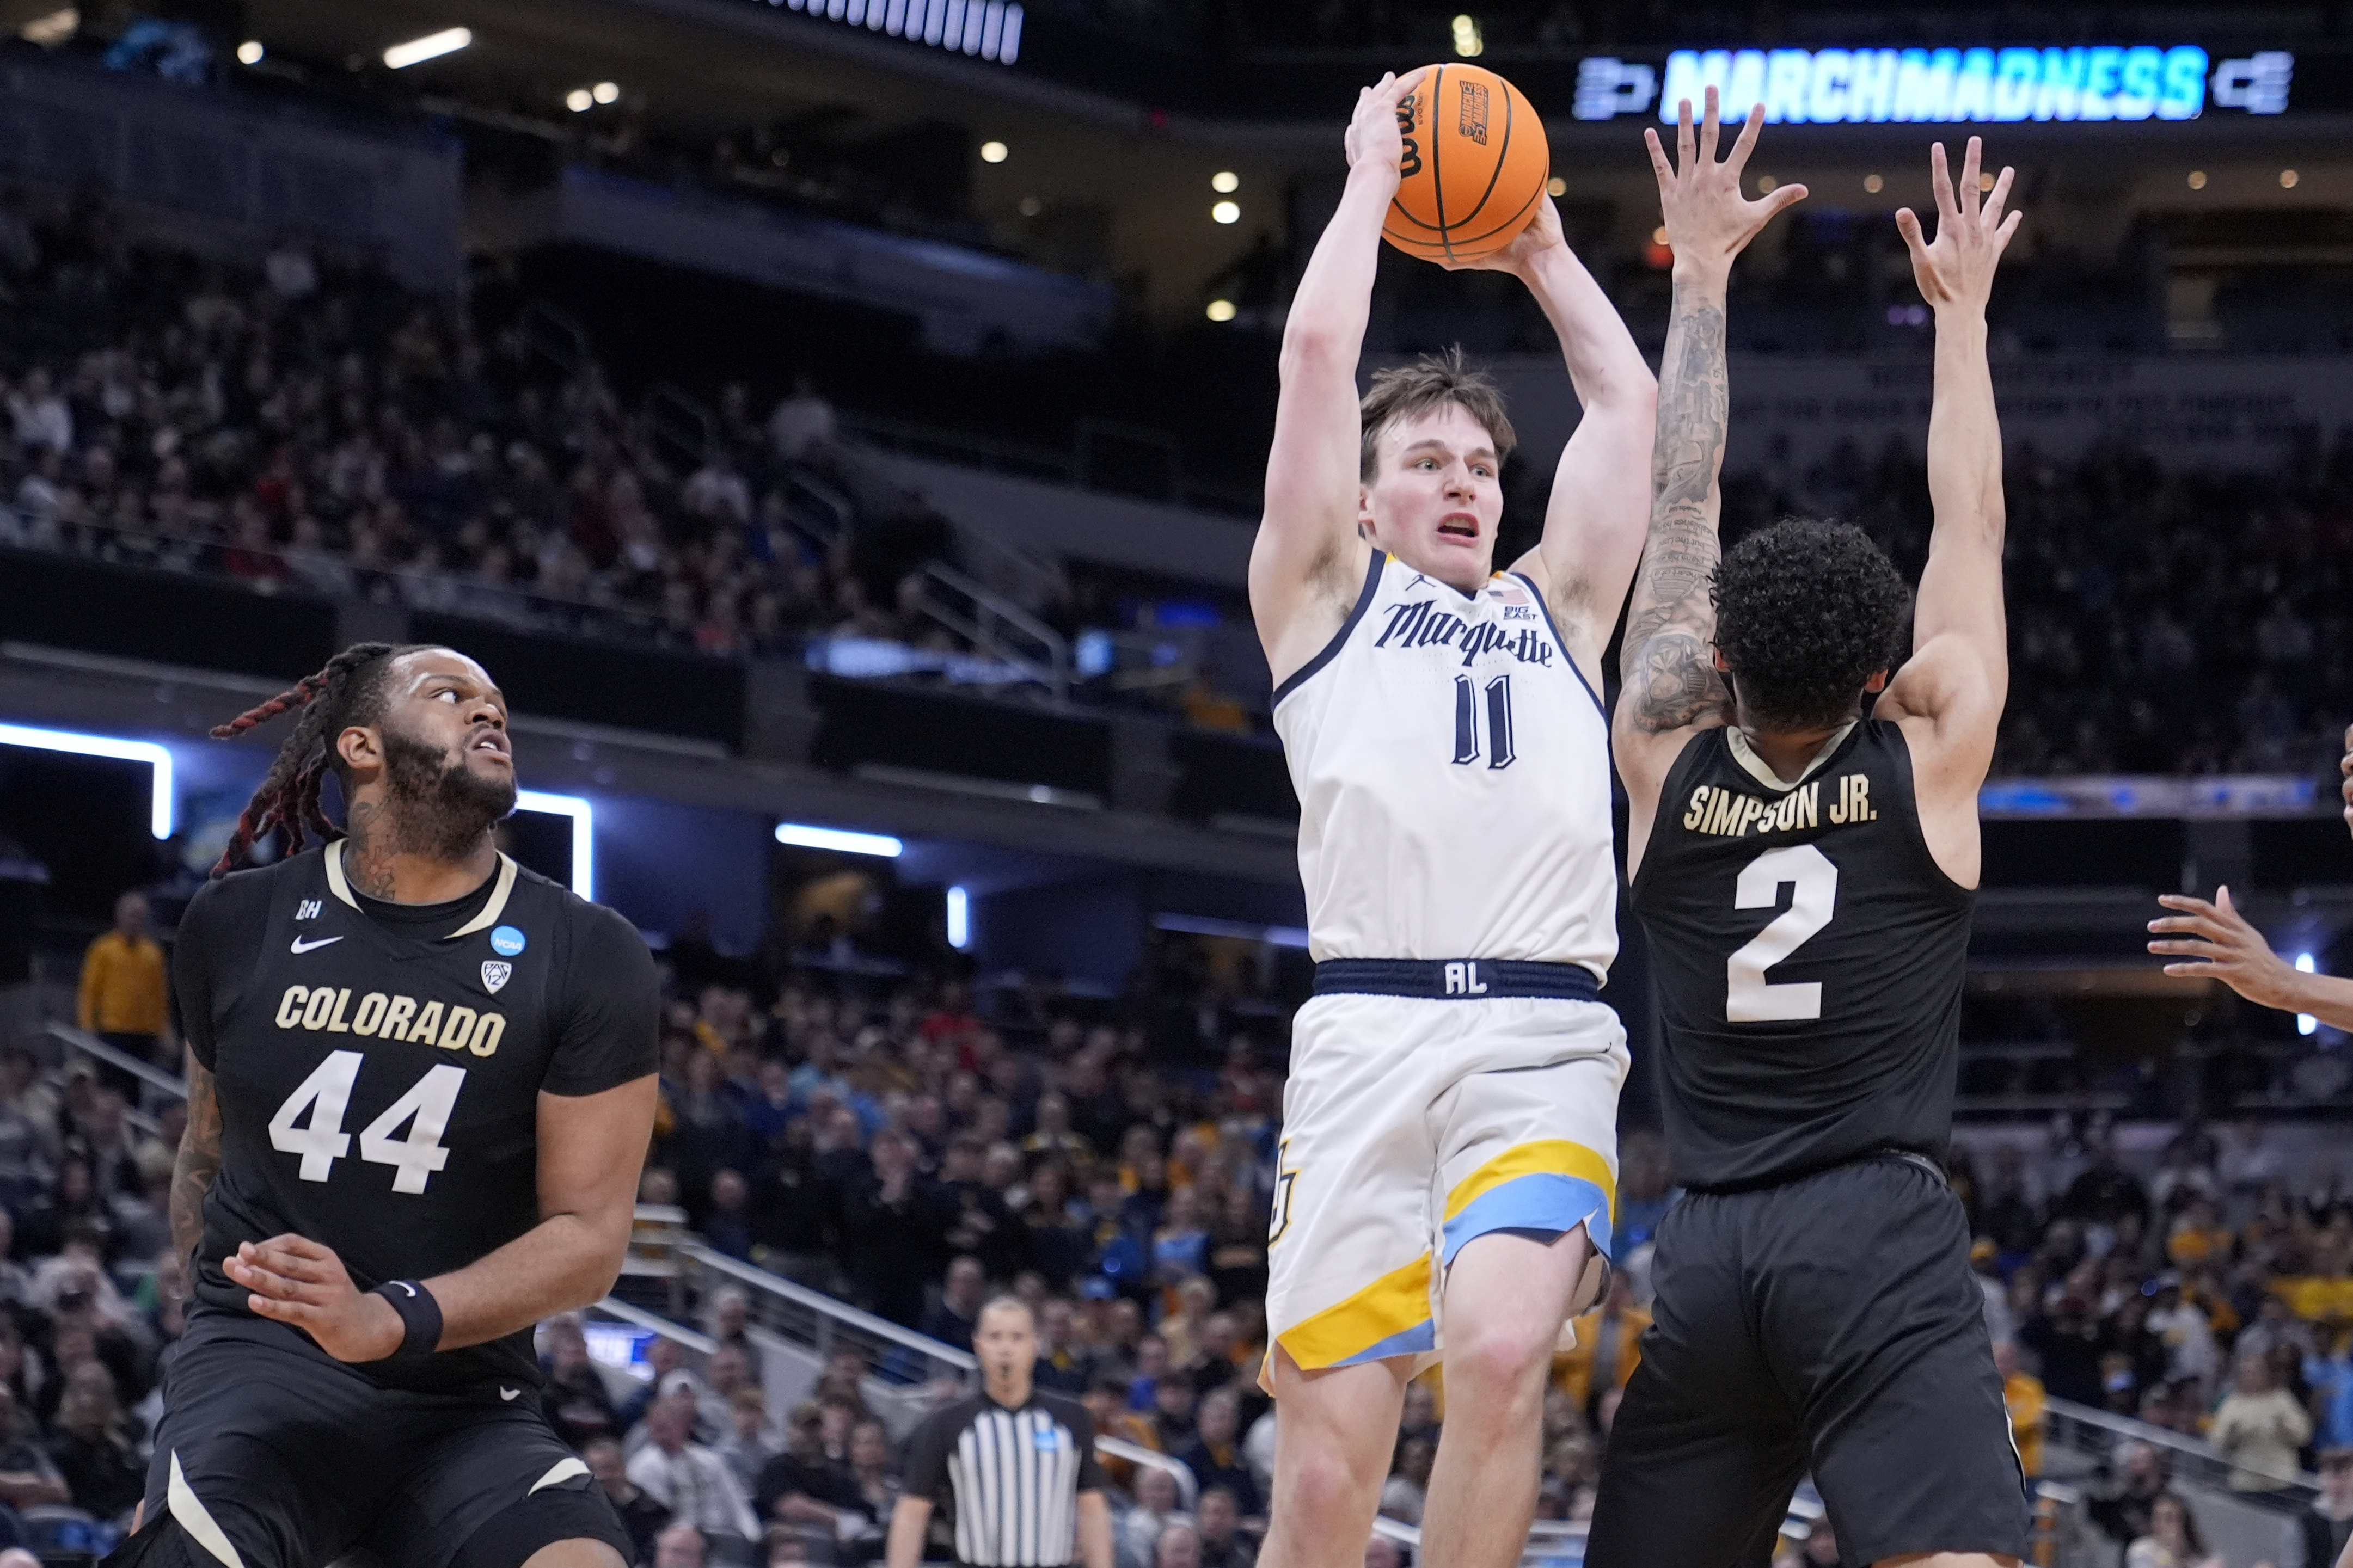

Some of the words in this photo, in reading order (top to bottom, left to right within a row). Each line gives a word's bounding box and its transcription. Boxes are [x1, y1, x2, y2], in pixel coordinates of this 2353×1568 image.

[1462, 93, 1474, 126] MARCH
[1473, 83, 1485, 126] MADNESS
[1375, 600, 1552, 667] Marquette
[1451, 673, 1517, 770] 11
[1683, 782, 1819, 837] SIMPSON
[1829, 773, 1878, 825] JR.
[295, 899, 322, 920] BH
[494, 937, 522, 951] NCAA
[1727, 844, 1839, 1022] 2
[484, 963, 509, 980] PAC
[488, 975, 501, 986] 12
[1444, 962, 1488, 995] AL
[275, 985, 506, 1057] COLORADO
[268, 1049, 467, 1195] 44
